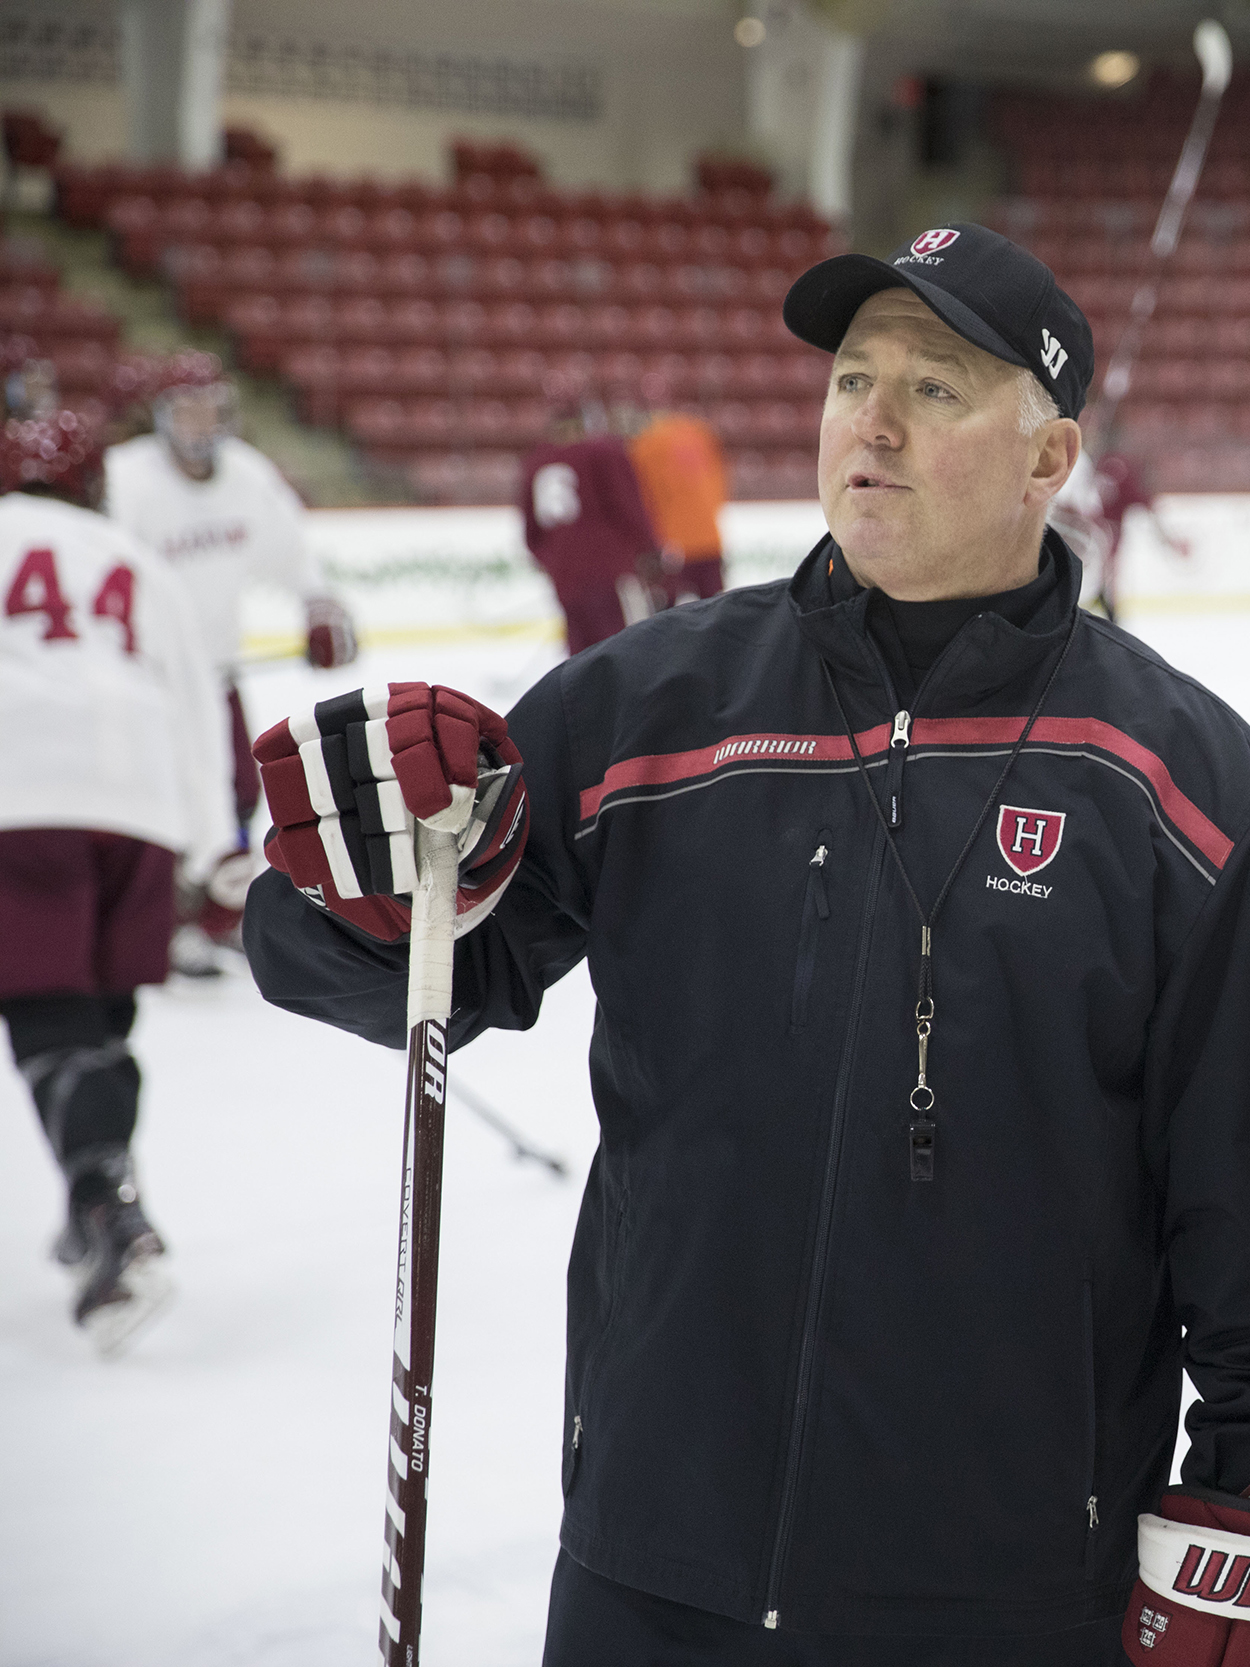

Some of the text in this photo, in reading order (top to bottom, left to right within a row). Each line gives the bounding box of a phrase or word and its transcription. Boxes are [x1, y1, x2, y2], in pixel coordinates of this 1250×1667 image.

[915, 231, 950, 250] H
[893, 255, 946, 267] HOCKEY
[5, 547, 136, 656] 44
[713, 739, 818, 765] WARRIOR
[1010, 815, 1049, 857] H
[986, 874, 1053, 899] HOCKEY
[424, 1018, 447, 1105] OR
[411, 1384, 428, 1473] T. DONATO
